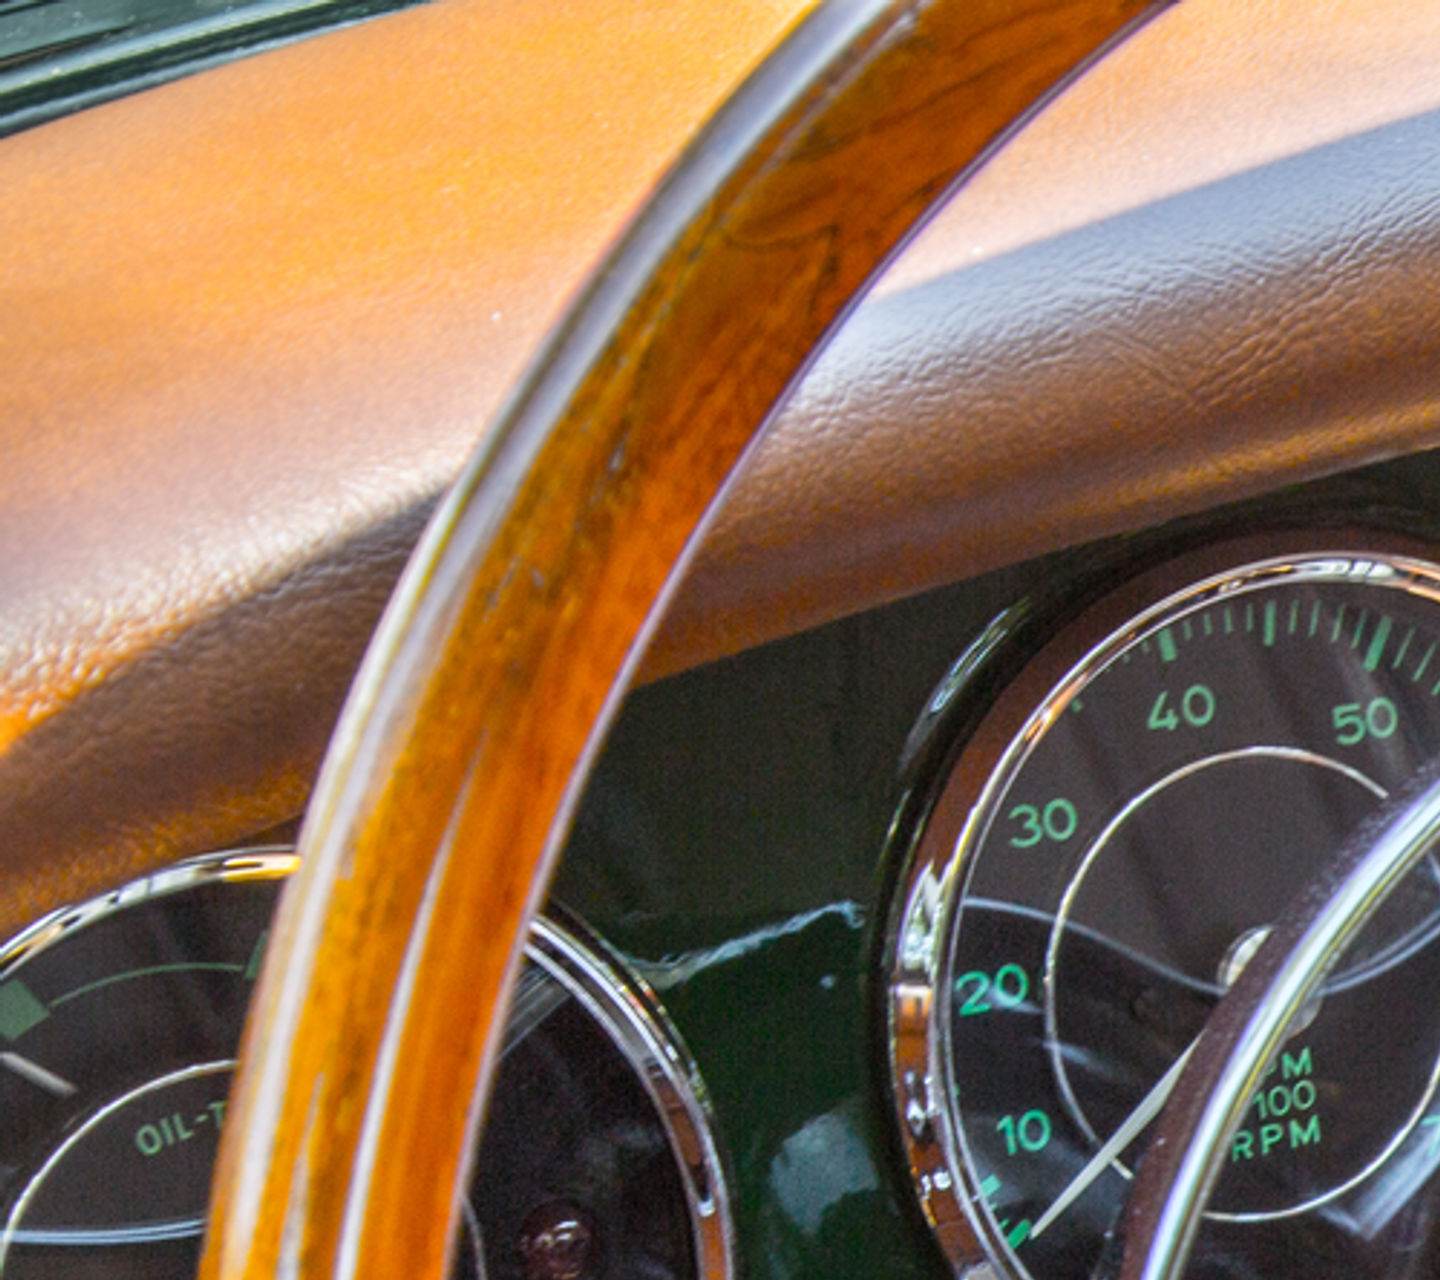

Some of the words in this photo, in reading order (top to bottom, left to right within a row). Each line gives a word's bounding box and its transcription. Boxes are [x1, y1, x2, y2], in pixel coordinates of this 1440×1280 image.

[1147, 684, 1216, 731] 40
[1332, 697, 1399, 745] 50
[1008, 798, 1078, 848] 30
[954, 963, 1029, 1017] 20
[1253, 1079, 1317, 1120] 100
[996, 1108, 1052, 1156] 10
[1231, 1113, 1321, 1163] RPM
